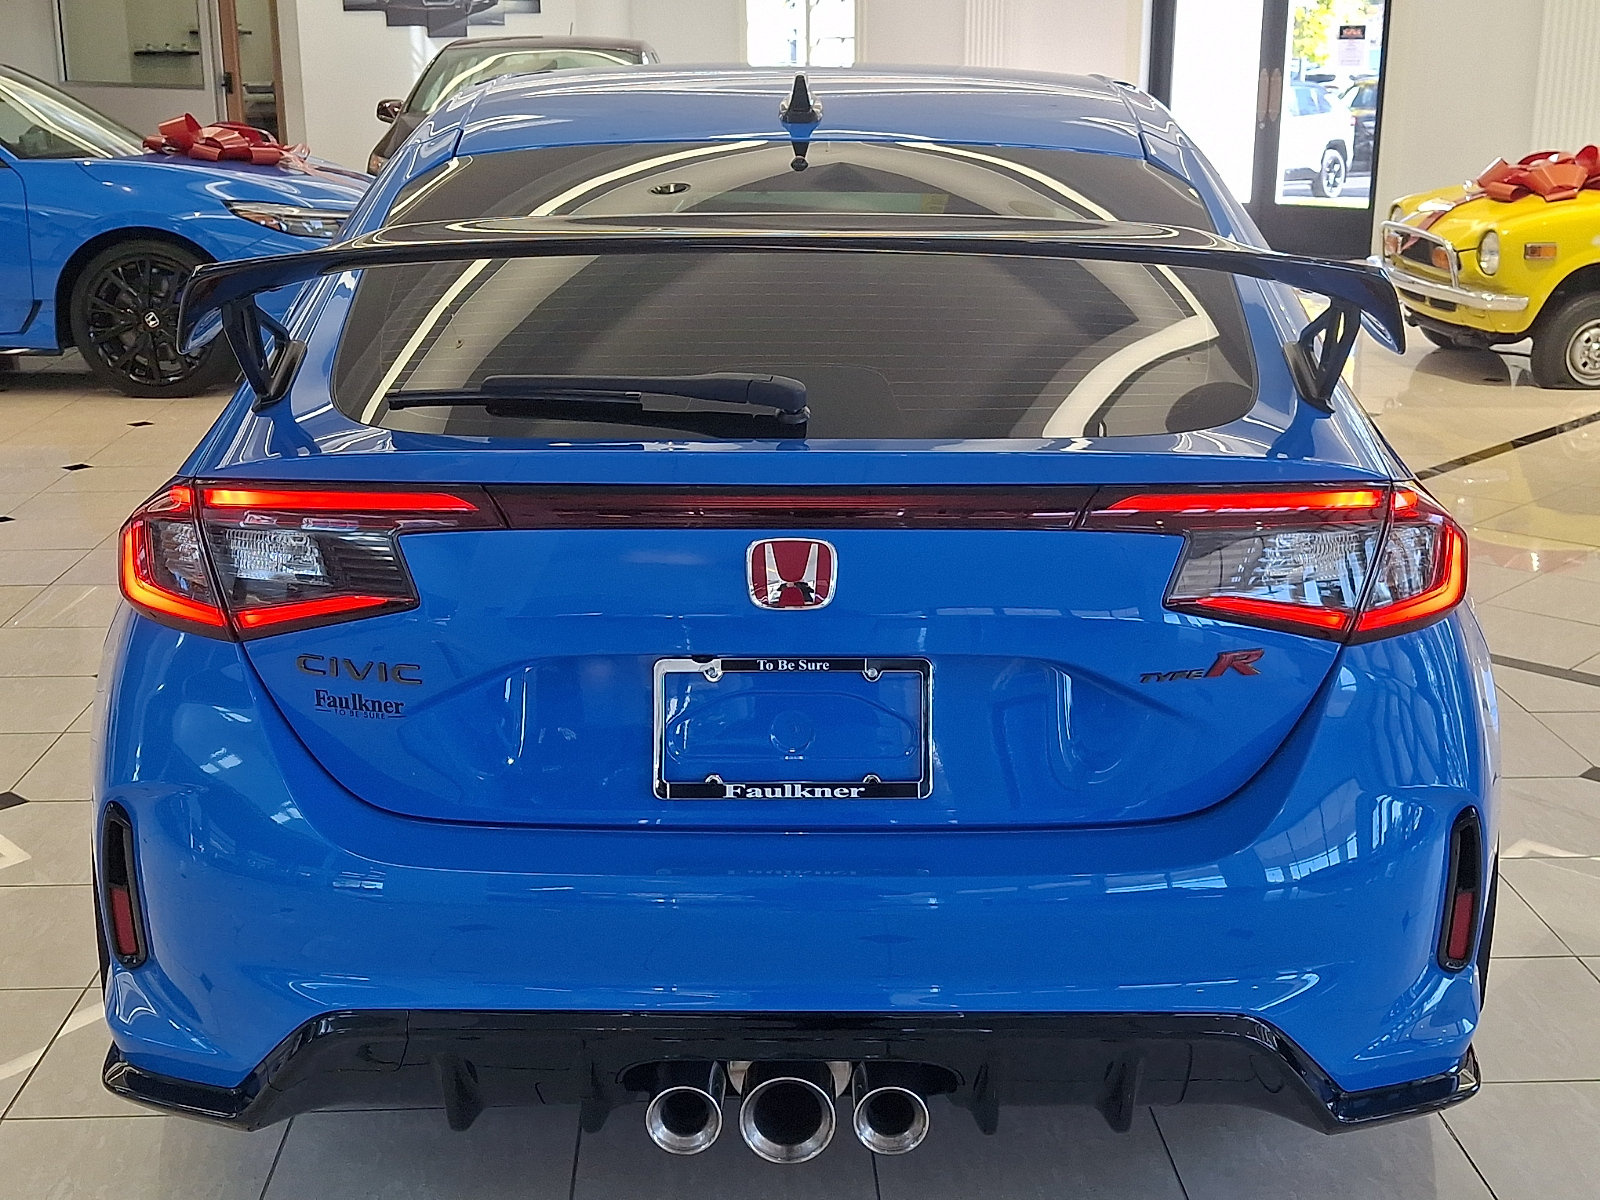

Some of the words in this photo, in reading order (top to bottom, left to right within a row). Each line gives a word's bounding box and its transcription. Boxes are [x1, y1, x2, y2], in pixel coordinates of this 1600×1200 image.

[296, 653, 423, 685] CIVIC
[756, 660, 774, 671] To
[778, 660, 796, 671] Be
[798, 660, 830, 671] Sure
[1140, 668, 1204, 683] TYPE
[1204, 648, 1265, 678] R
[315, 689, 404, 714] Faulkner
[723, 784, 865, 798] Faulkner
